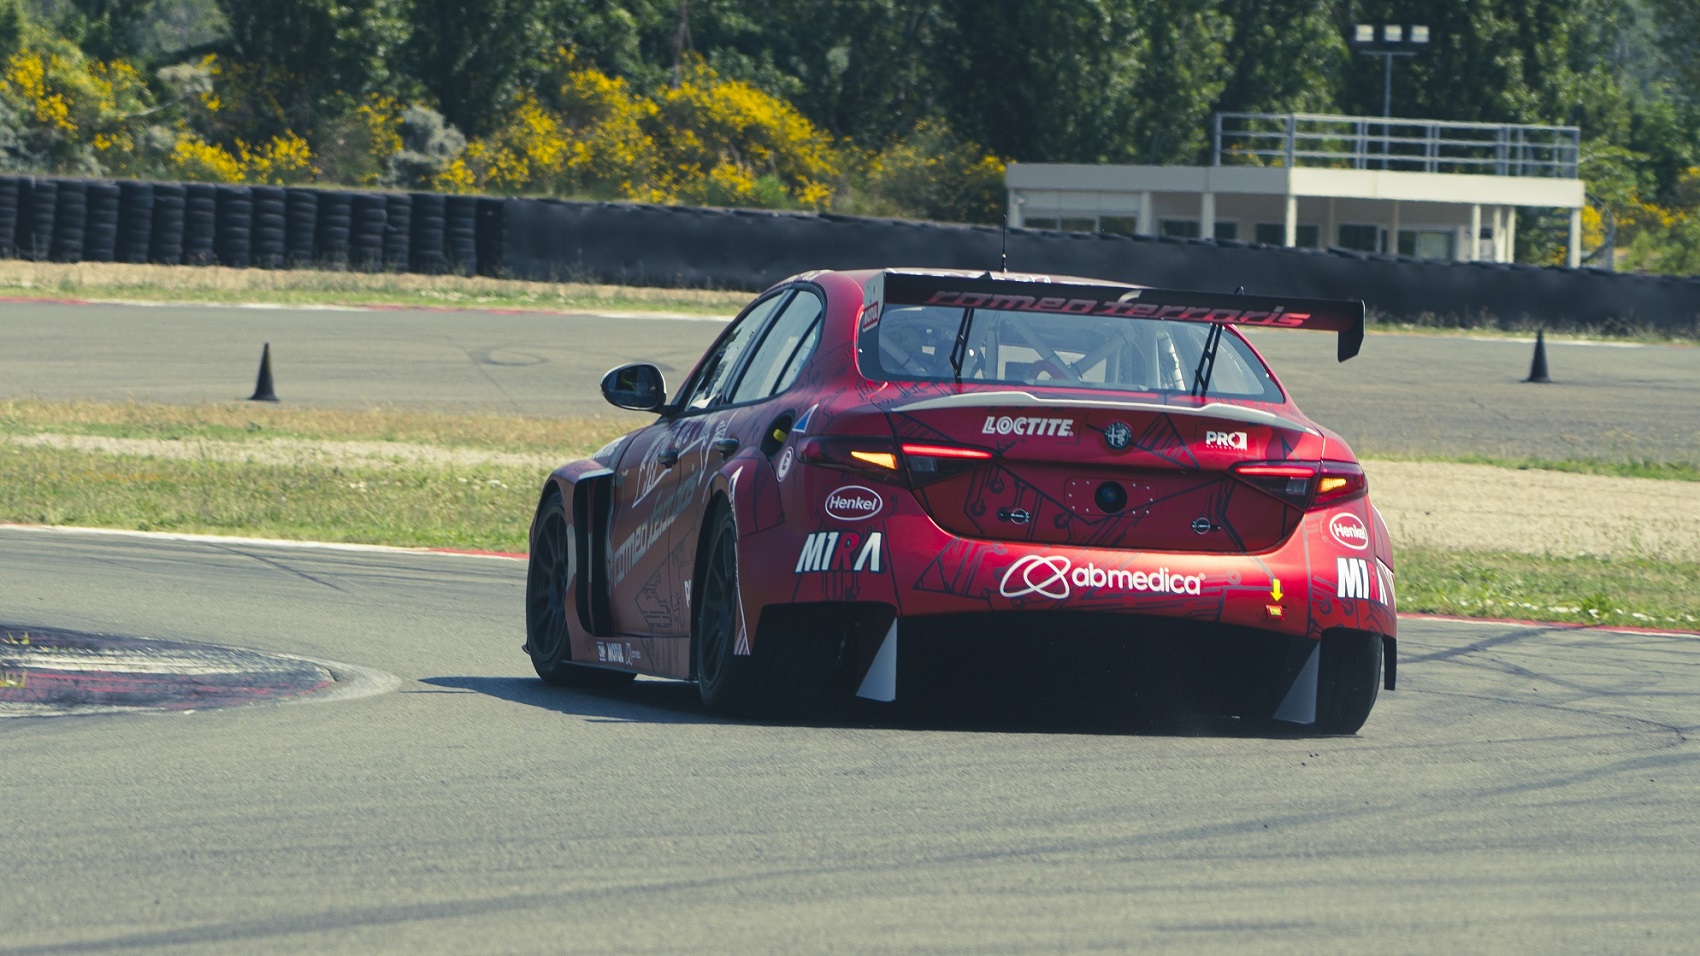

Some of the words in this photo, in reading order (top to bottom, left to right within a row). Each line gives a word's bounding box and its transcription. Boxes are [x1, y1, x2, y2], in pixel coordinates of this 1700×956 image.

[928, 291, 1097, 314] romeo
[1094, 290, 1310, 327] ferraris
[982, 416, 1073, 436] LOCTITE
[829, 496, 877, 511] Henkel
[1333, 523, 1367, 540] Henkel
